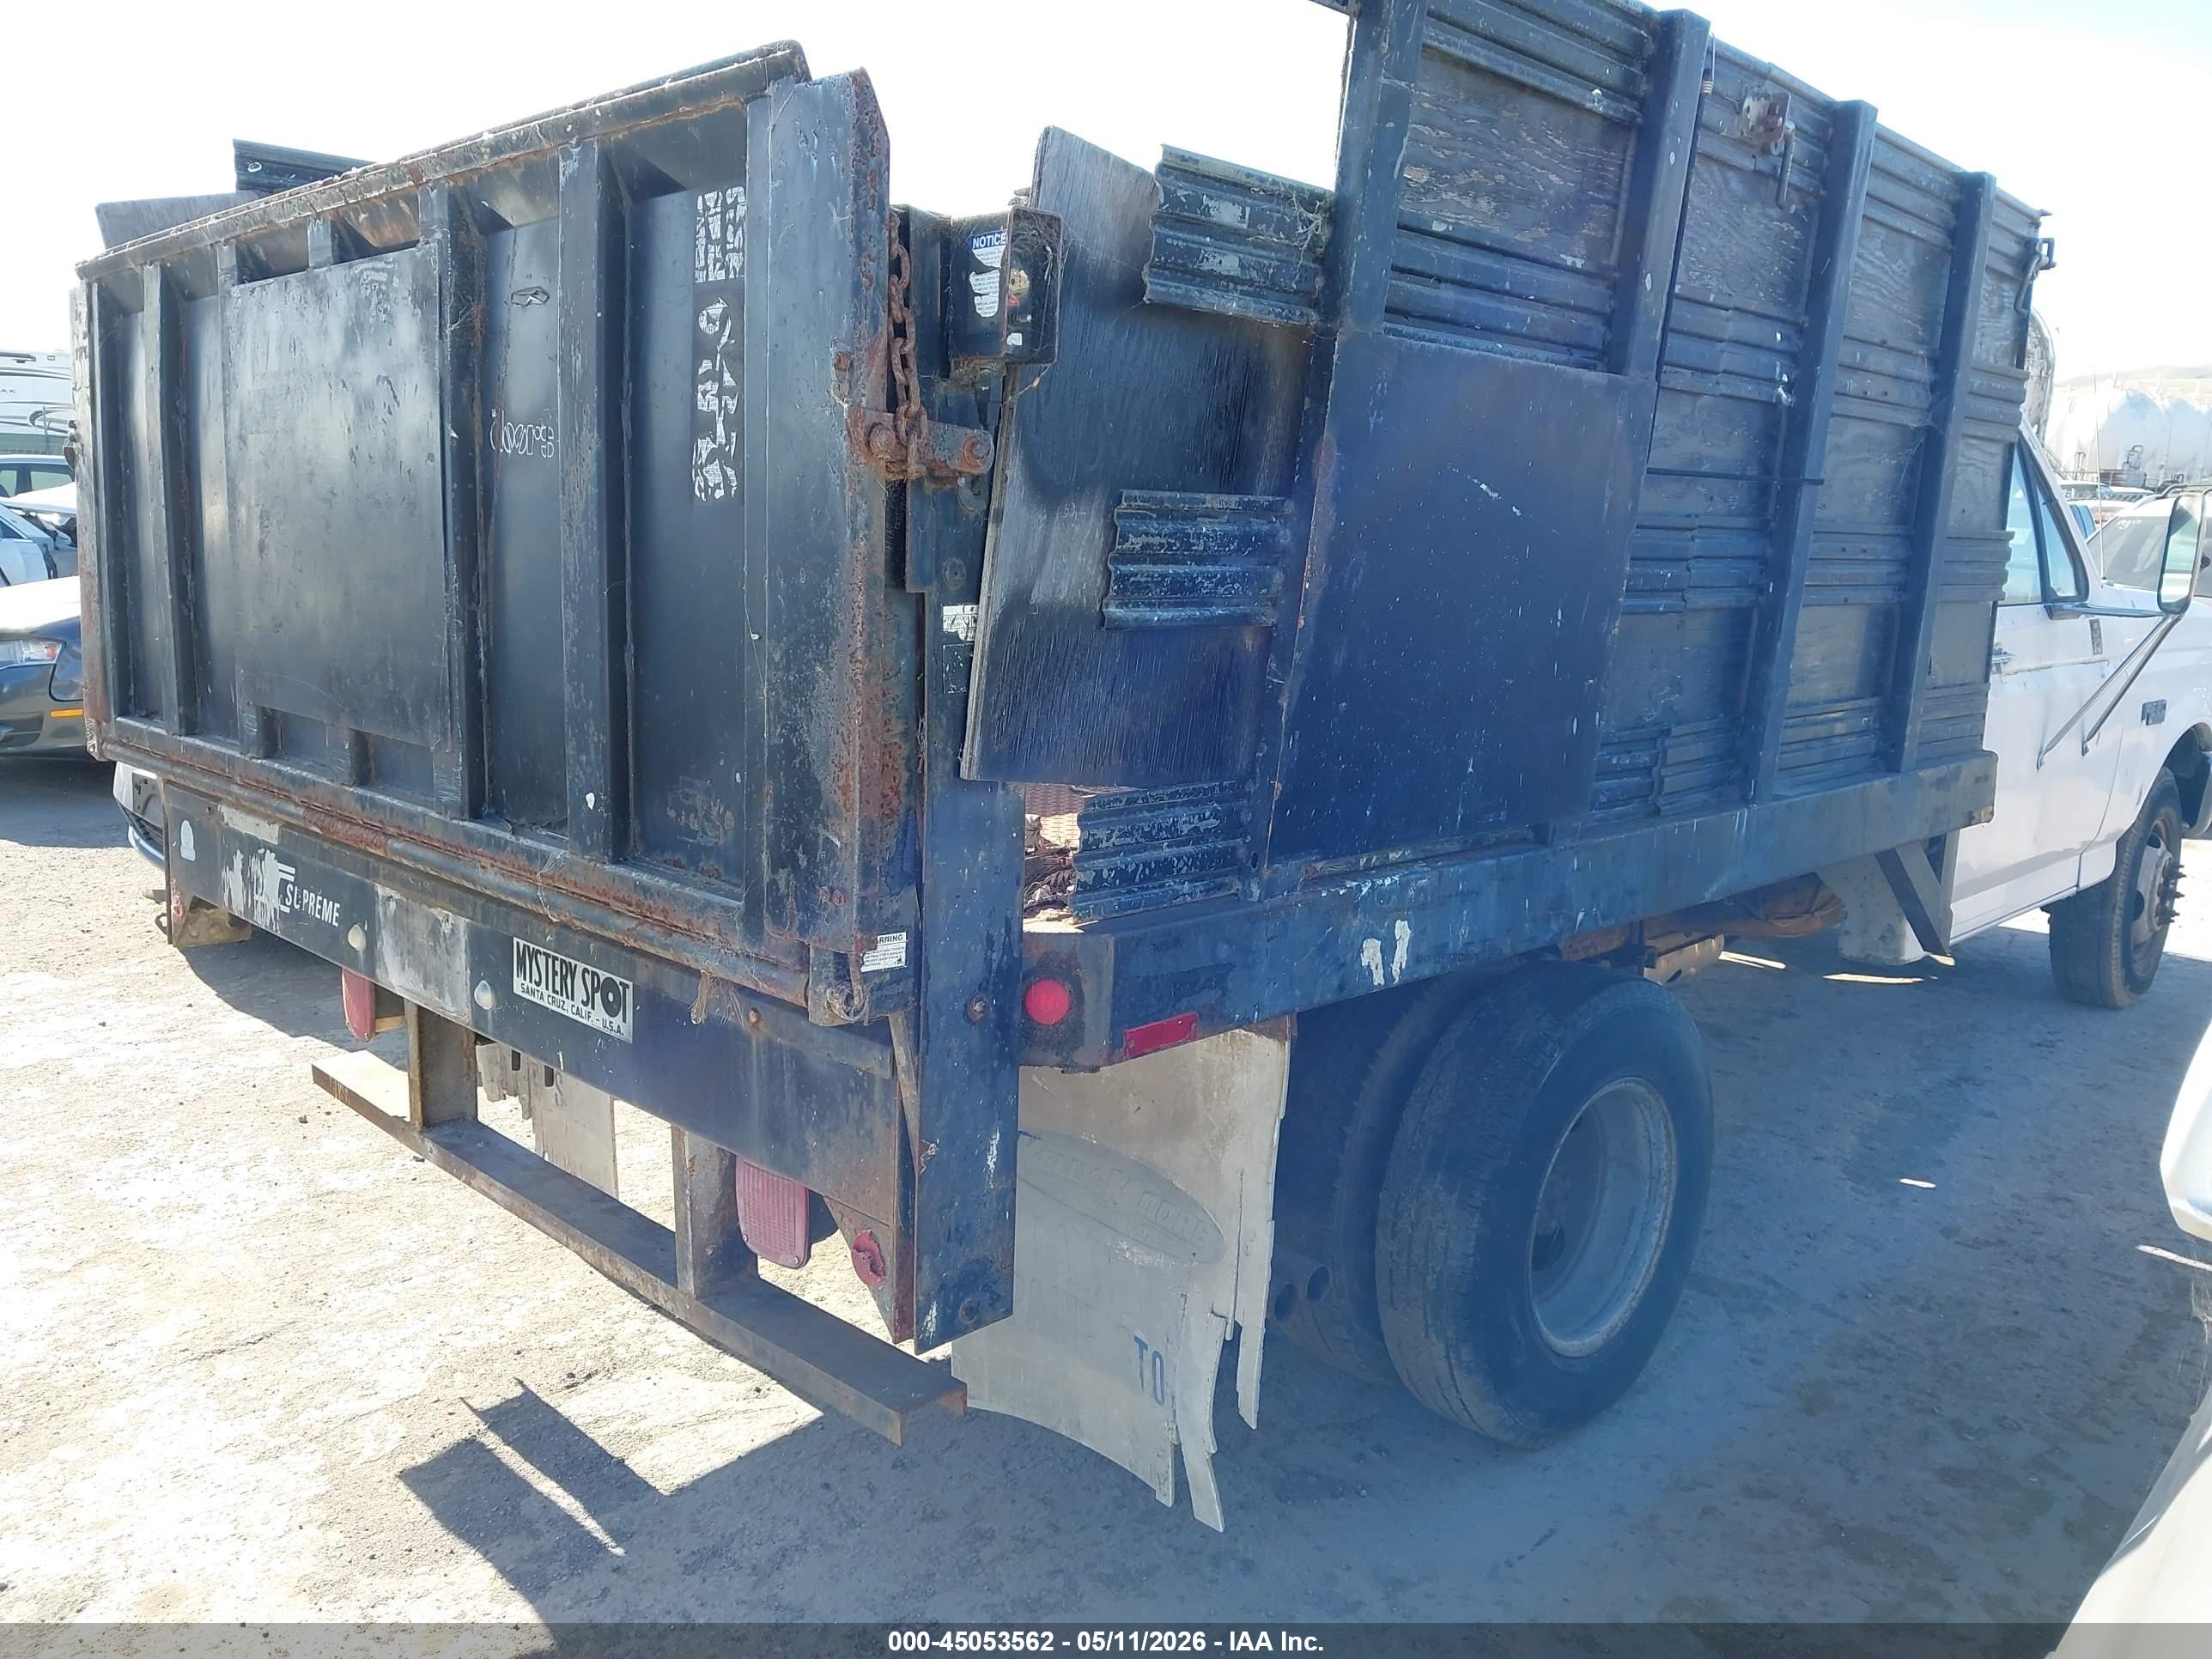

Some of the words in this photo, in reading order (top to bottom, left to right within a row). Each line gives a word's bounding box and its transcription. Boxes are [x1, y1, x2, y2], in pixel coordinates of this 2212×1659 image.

[973, 233, 1006, 249] NOTICE
[286, 884, 341, 927] SUPREME
[517, 941, 577, 1002] MYSTERY
[581, 967, 629, 1024] SPOT
[520, 983, 544, 1003] SANTA
[547, 994, 568, 1012] CRUZ,
[571, 1004, 593, 1023] CALIF.
[602, 1018, 624, 1036] U.S.A.
